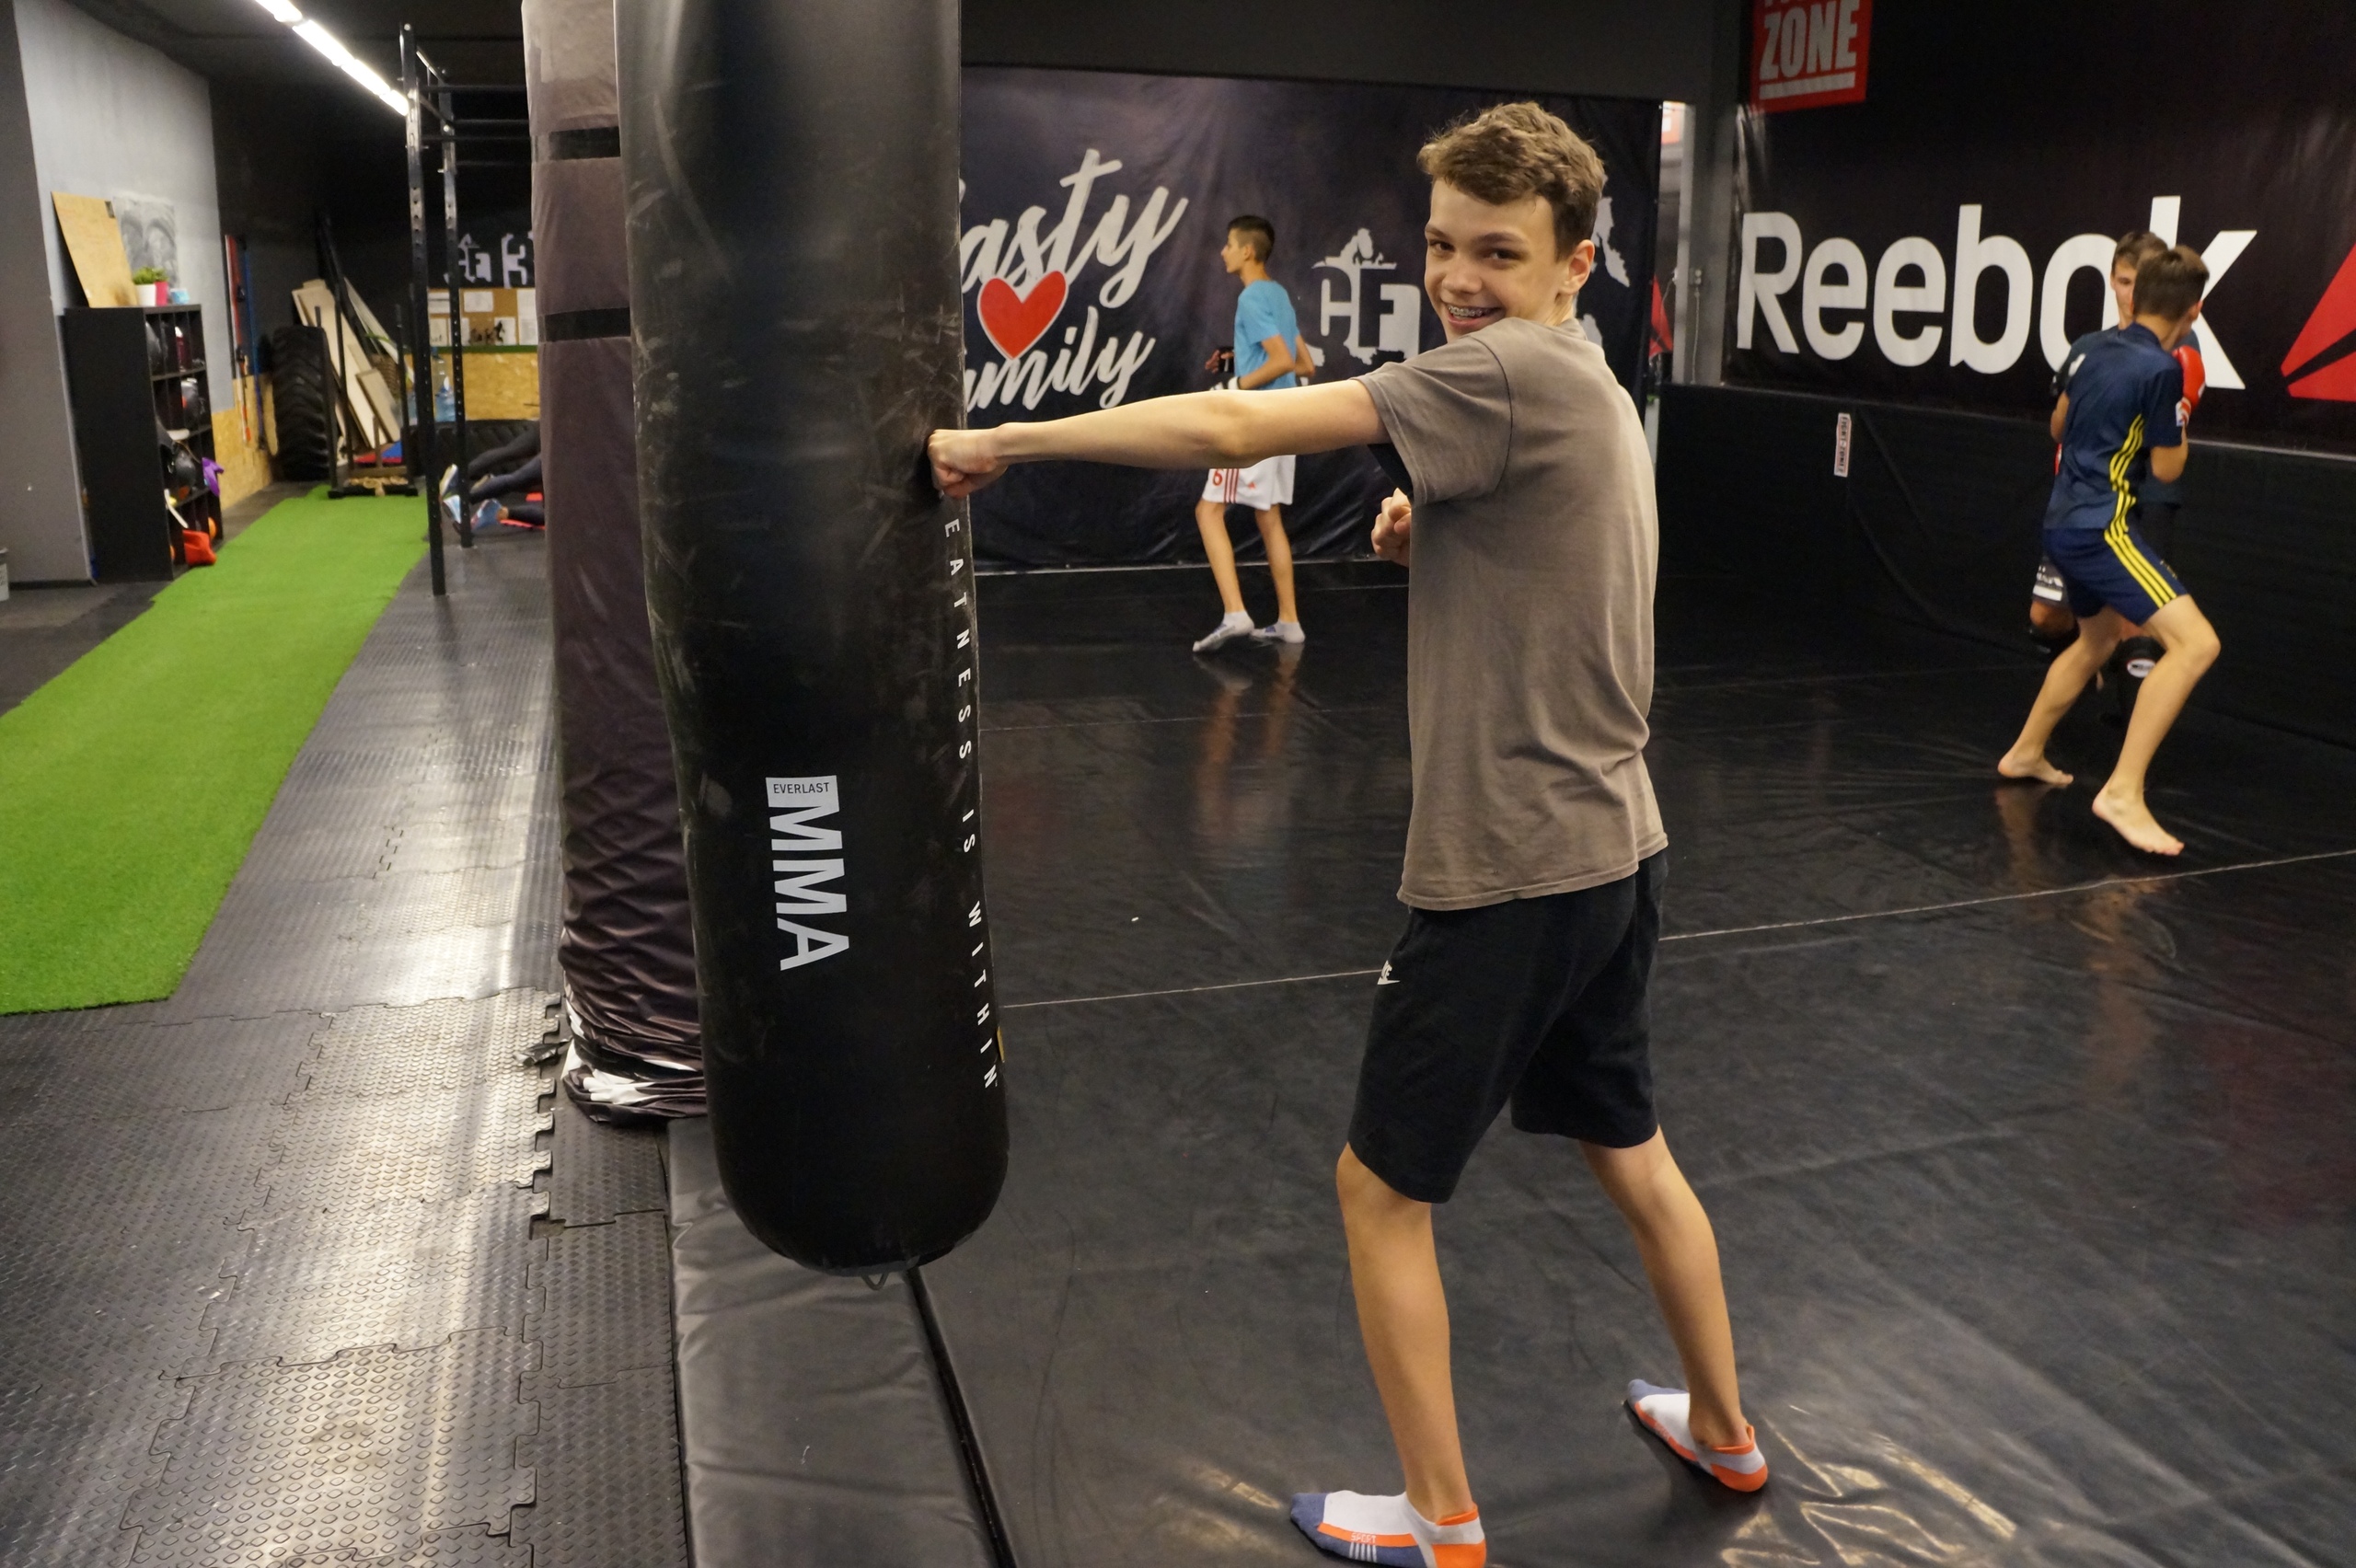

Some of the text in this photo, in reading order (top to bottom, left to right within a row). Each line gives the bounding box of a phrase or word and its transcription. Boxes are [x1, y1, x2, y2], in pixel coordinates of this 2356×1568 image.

[1759, 0, 1859, 81] ZONE
[959, 148, 1189, 308] asty
[1738, 195, 2257, 390] Reebok
[964, 306, 1156, 411] mily
[773, 782, 830, 794] EVERLAST
[944, 518, 997, 1089] EATNESS IS WITHIN
[766, 775, 849, 972] MMA
